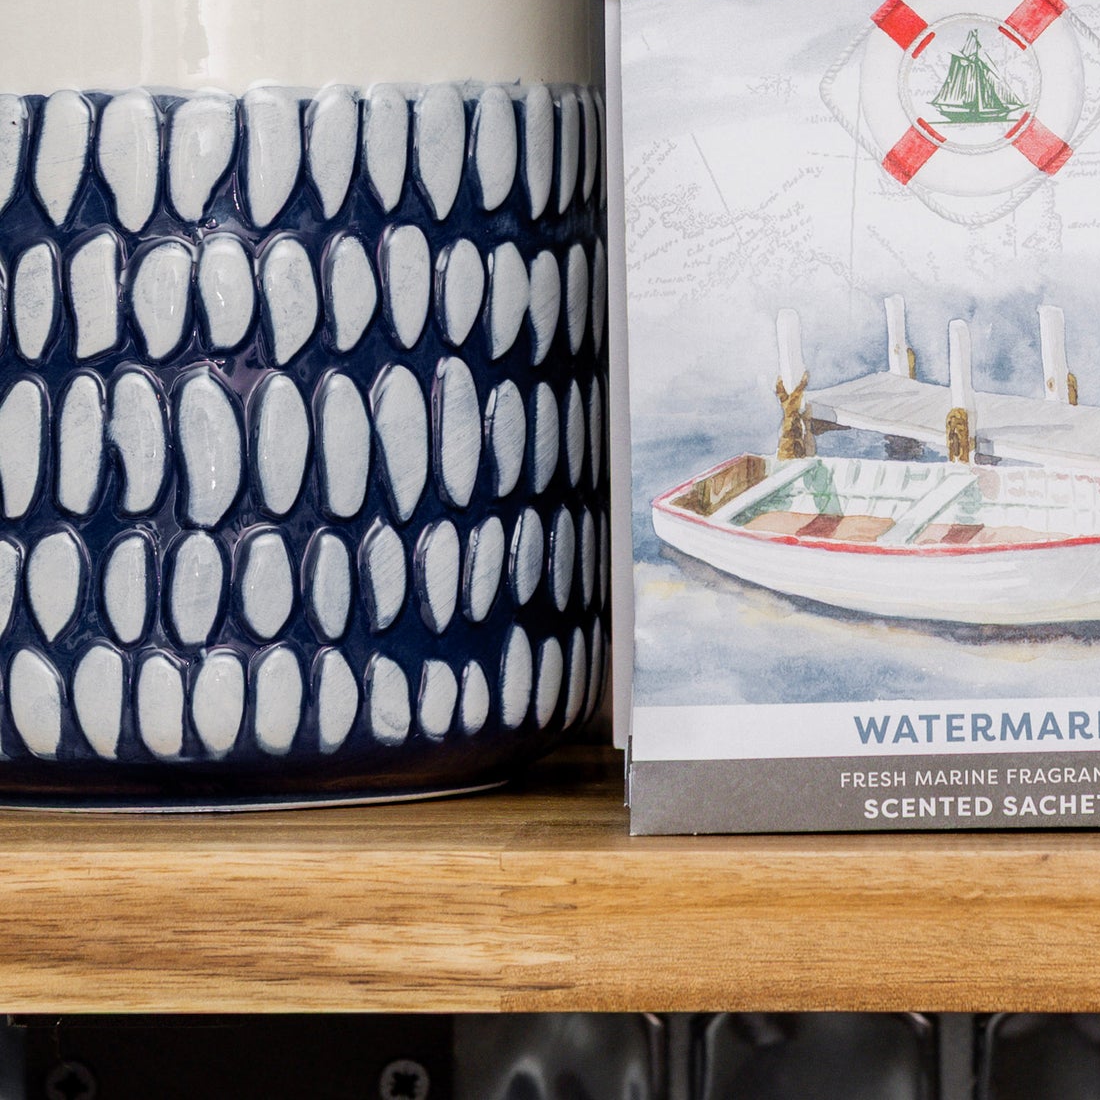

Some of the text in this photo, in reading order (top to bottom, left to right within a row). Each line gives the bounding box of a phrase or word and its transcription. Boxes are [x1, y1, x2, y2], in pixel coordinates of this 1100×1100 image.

[840, 771, 906, 788] FRESH
[915, 768, 998, 786] MARINE
[863, 796, 993, 819] SCENTED
